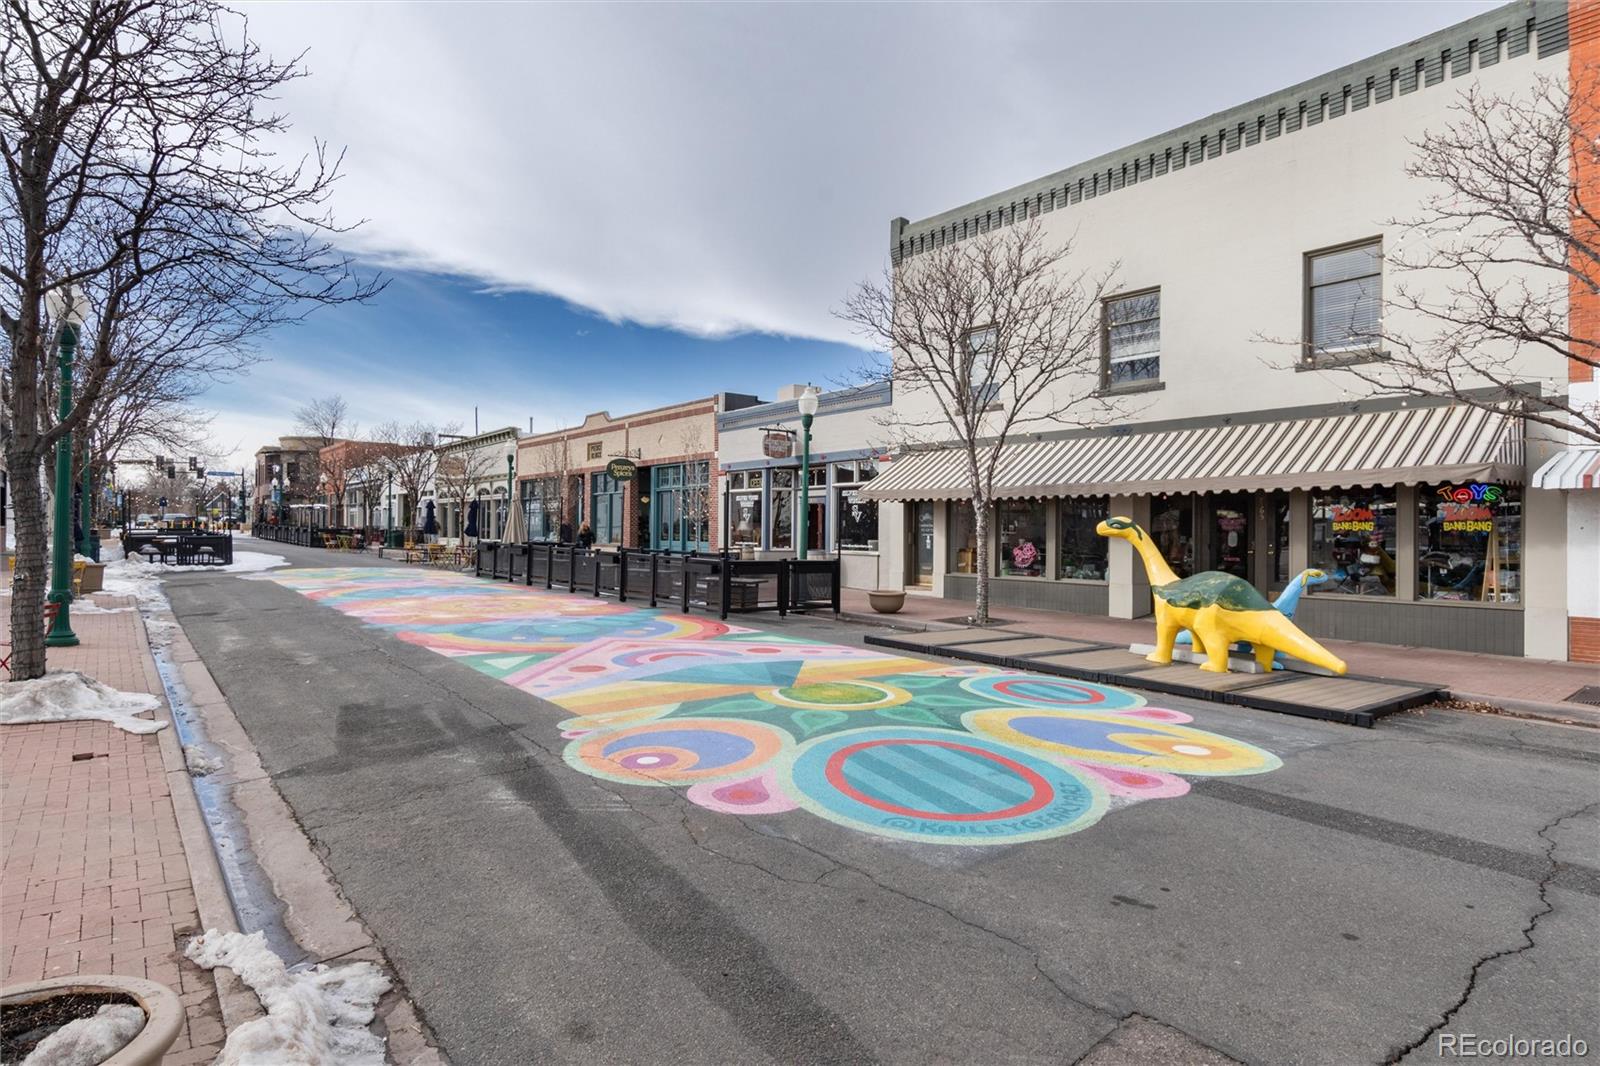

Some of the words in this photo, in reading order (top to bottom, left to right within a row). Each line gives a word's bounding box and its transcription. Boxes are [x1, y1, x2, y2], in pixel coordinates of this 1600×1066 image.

[1437, 484, 1503, 503] TOYS
[1352, 520, 1375, 532] BANG
[1443, 521, 1466, 532] BANG
[1466, 520, 1493, 532] BANG
